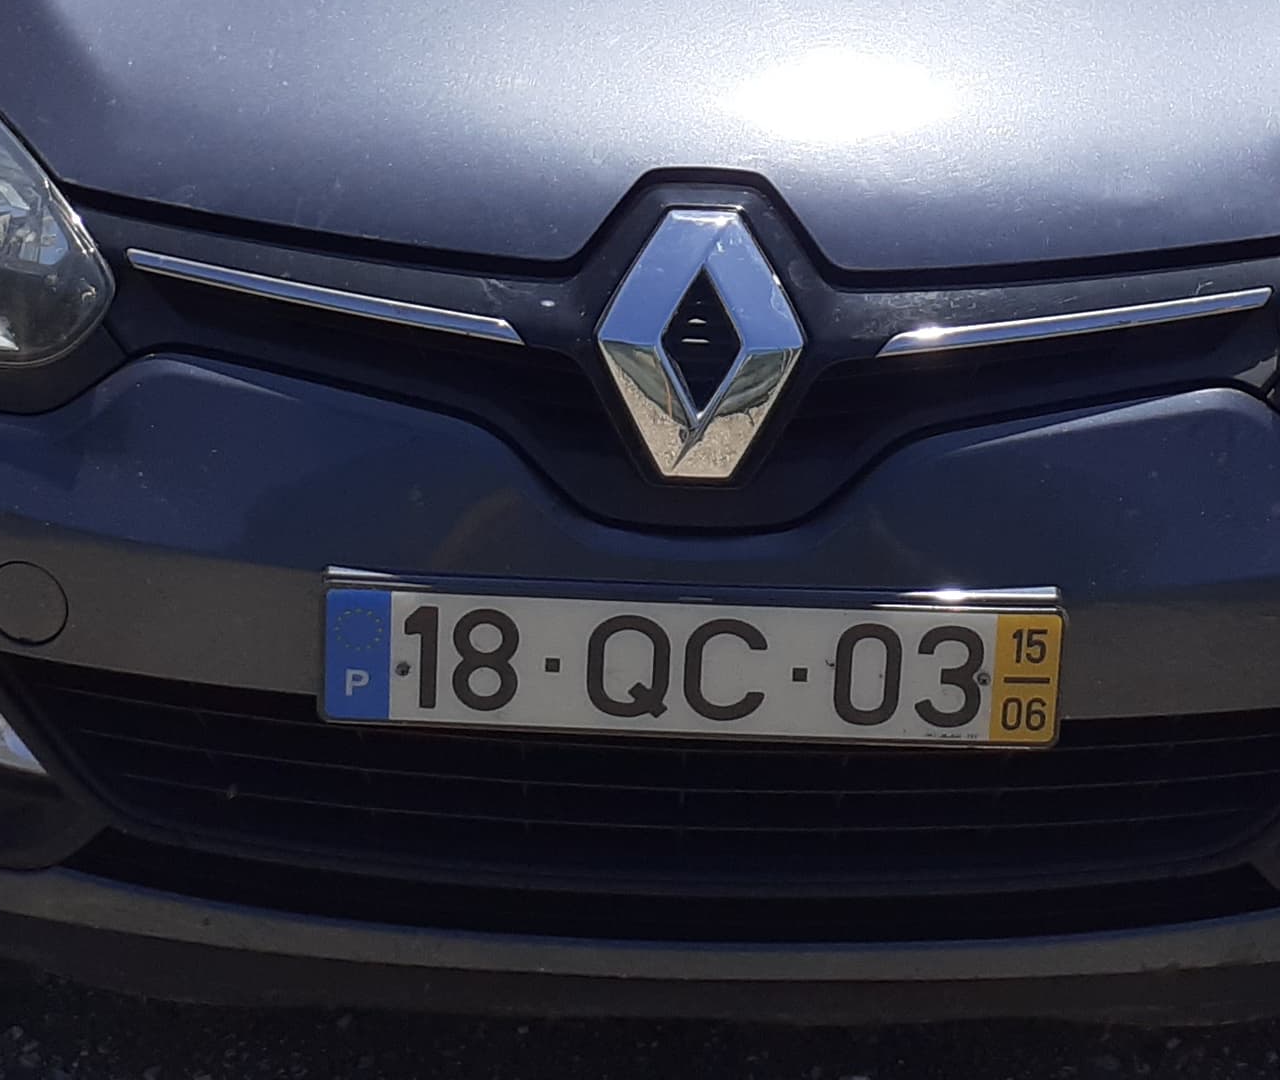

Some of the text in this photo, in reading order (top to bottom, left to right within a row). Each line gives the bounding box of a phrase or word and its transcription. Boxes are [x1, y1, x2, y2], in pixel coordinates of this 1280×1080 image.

[1012, 629, 1048, 664] 15
[345, 668, 369, 696] P
[1001, 697, 1047, 731] 06
